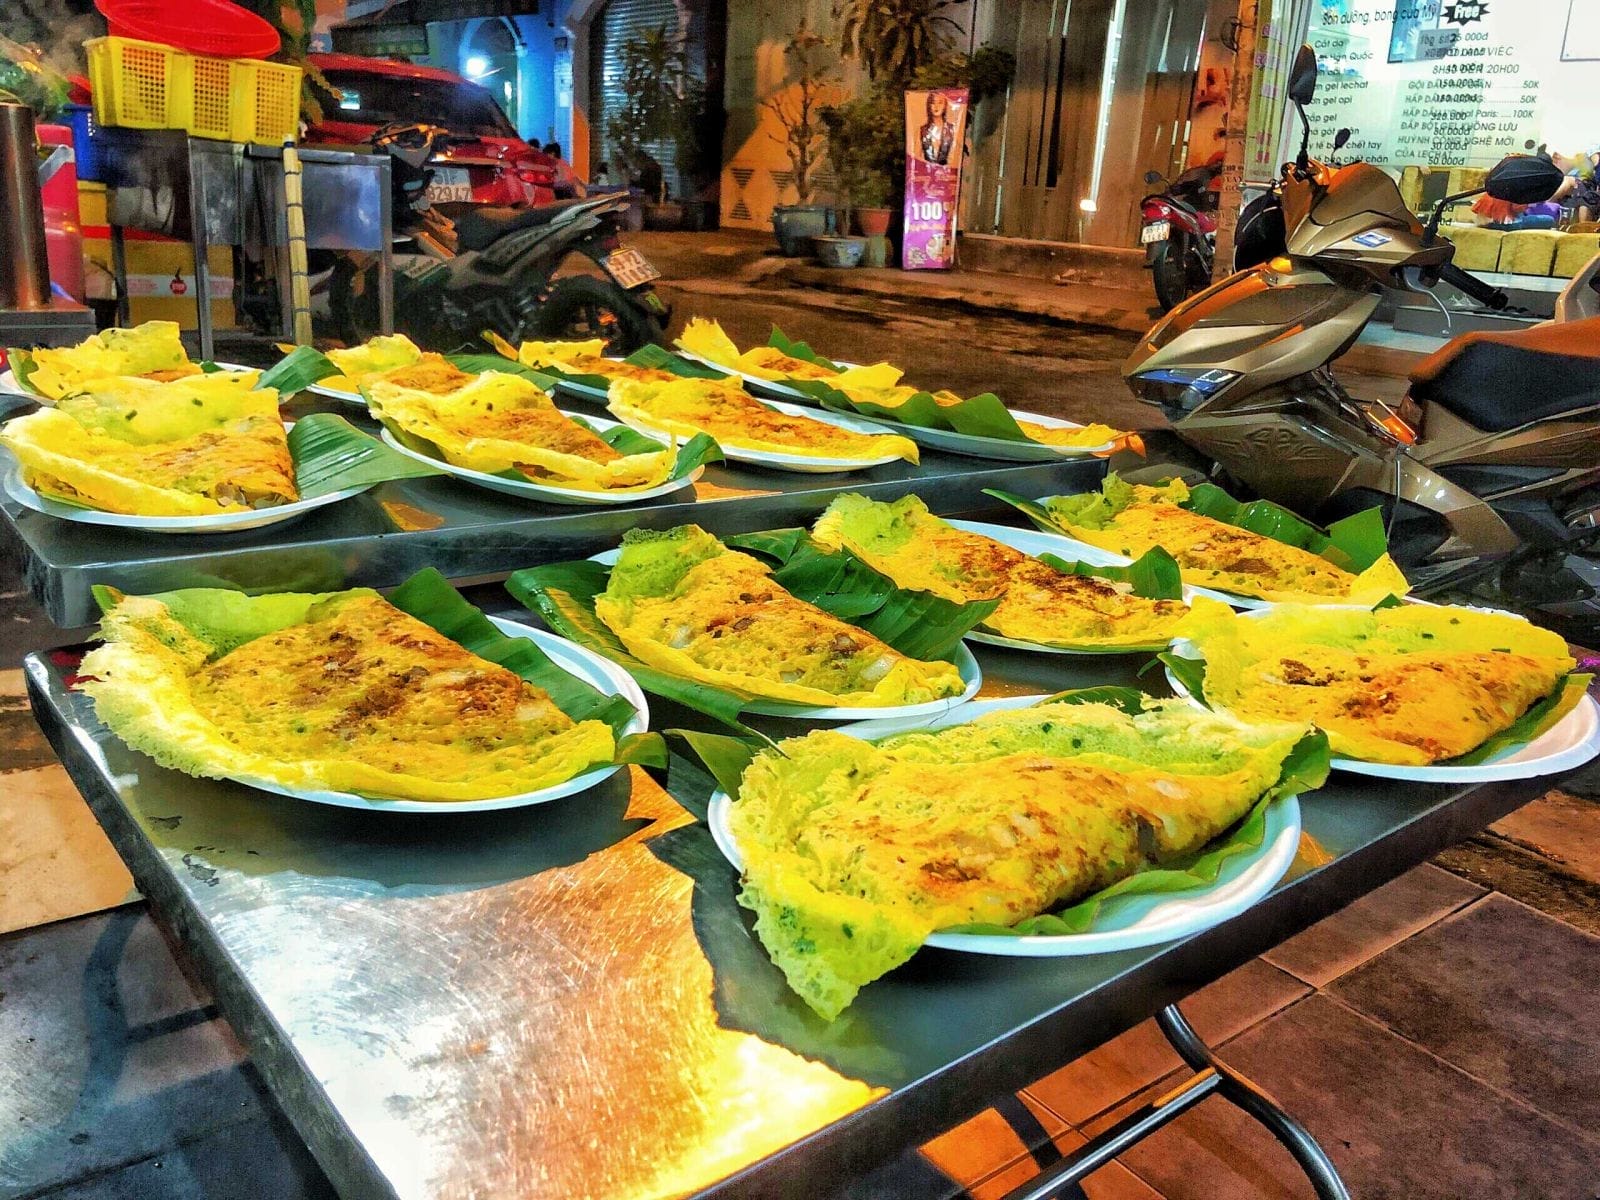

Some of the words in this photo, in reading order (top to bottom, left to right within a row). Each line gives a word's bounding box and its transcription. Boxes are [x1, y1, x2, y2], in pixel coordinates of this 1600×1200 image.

[1454, 4, 1480, 19] Free
[1487, 64, 1520, 74] 20H00
[1325, 82, 1339, 91] gel
[1340, 81, 1368, 89] lechat
[1522, 80, 1540, 89] 50K
[1323, 97, 1336, 105] gel
[1339, 96, 1352, 105] opi
[1520, 95, 1537, 103] 50K
[1513, 109, 1534, 118] 100K
[1323, 114, 1337, 123] gel
[1368, 141, 1382, 150] tay
